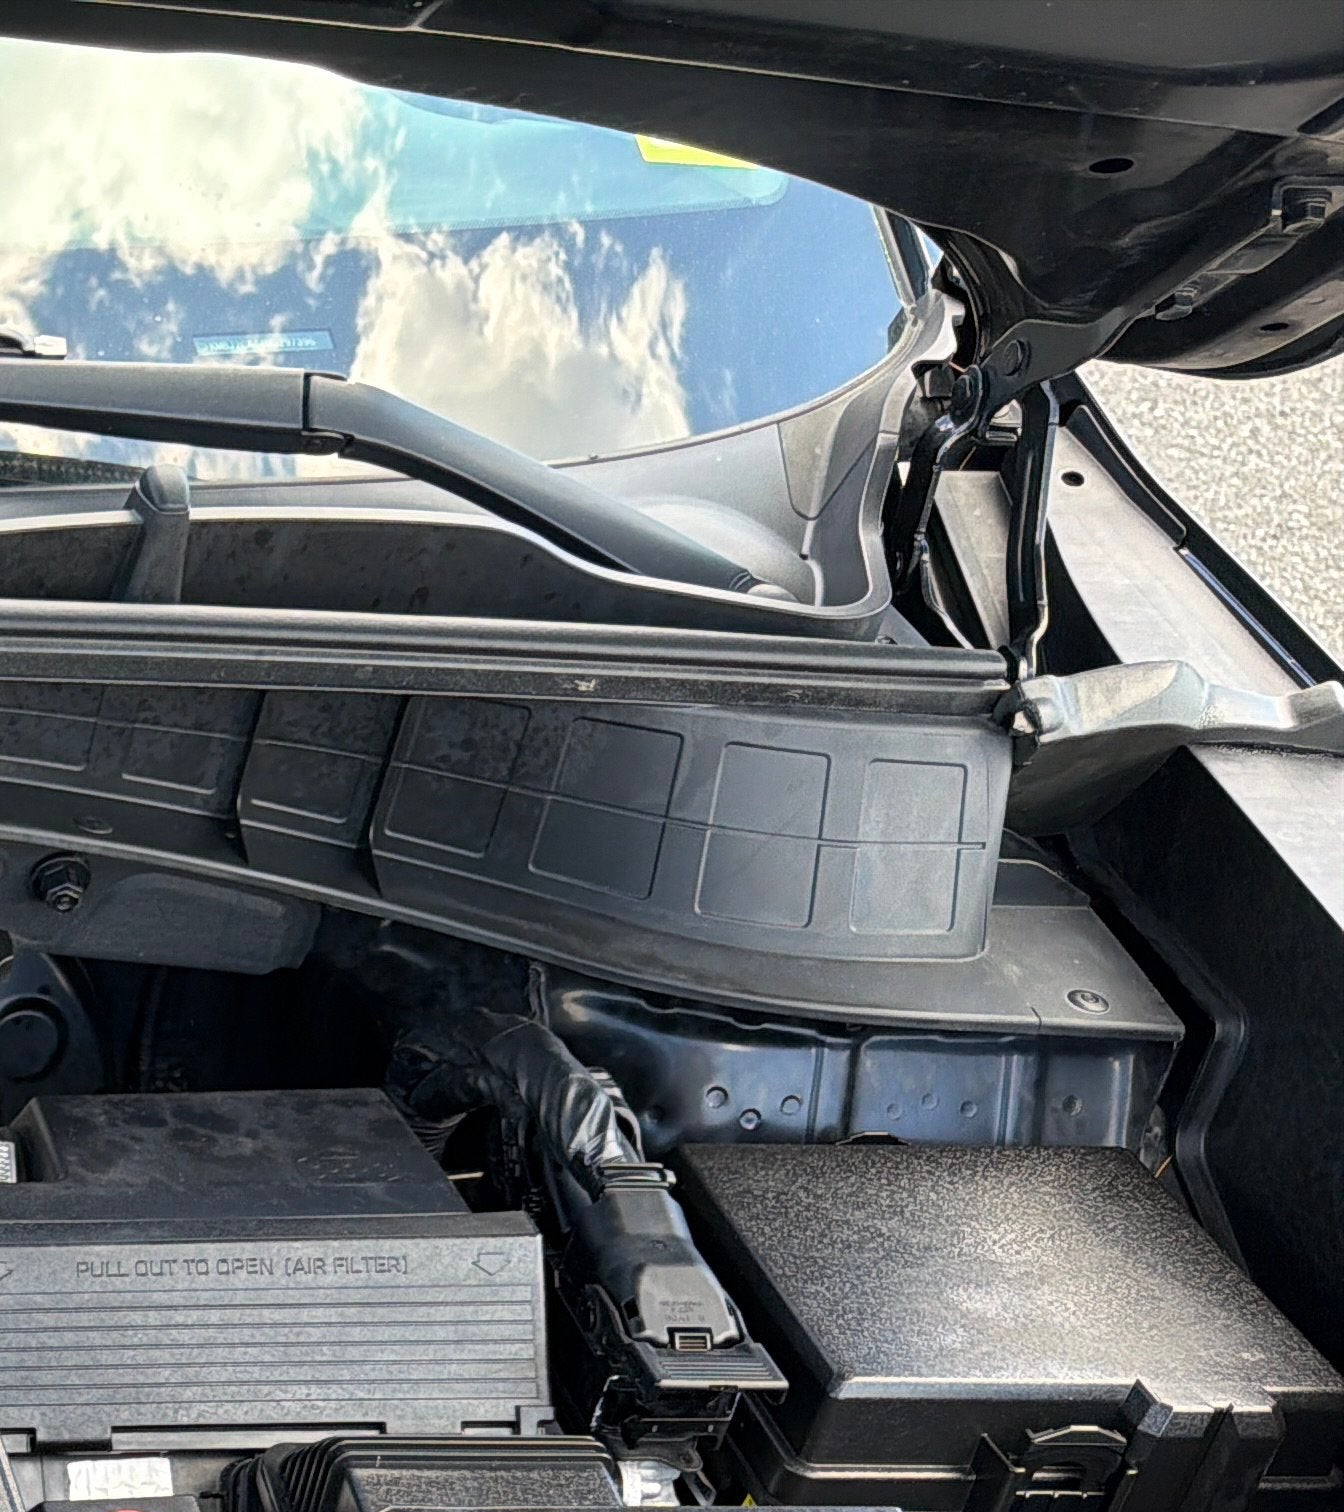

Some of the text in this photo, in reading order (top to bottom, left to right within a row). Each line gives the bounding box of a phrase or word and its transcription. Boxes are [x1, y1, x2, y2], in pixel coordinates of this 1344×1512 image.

[76, 1260, 130, 1279] PULL
[135, 1259, 178, 1278] OUT
[183, 1258, 210, 1277] TO
[216, 1257, 274, 1277] OPEN
